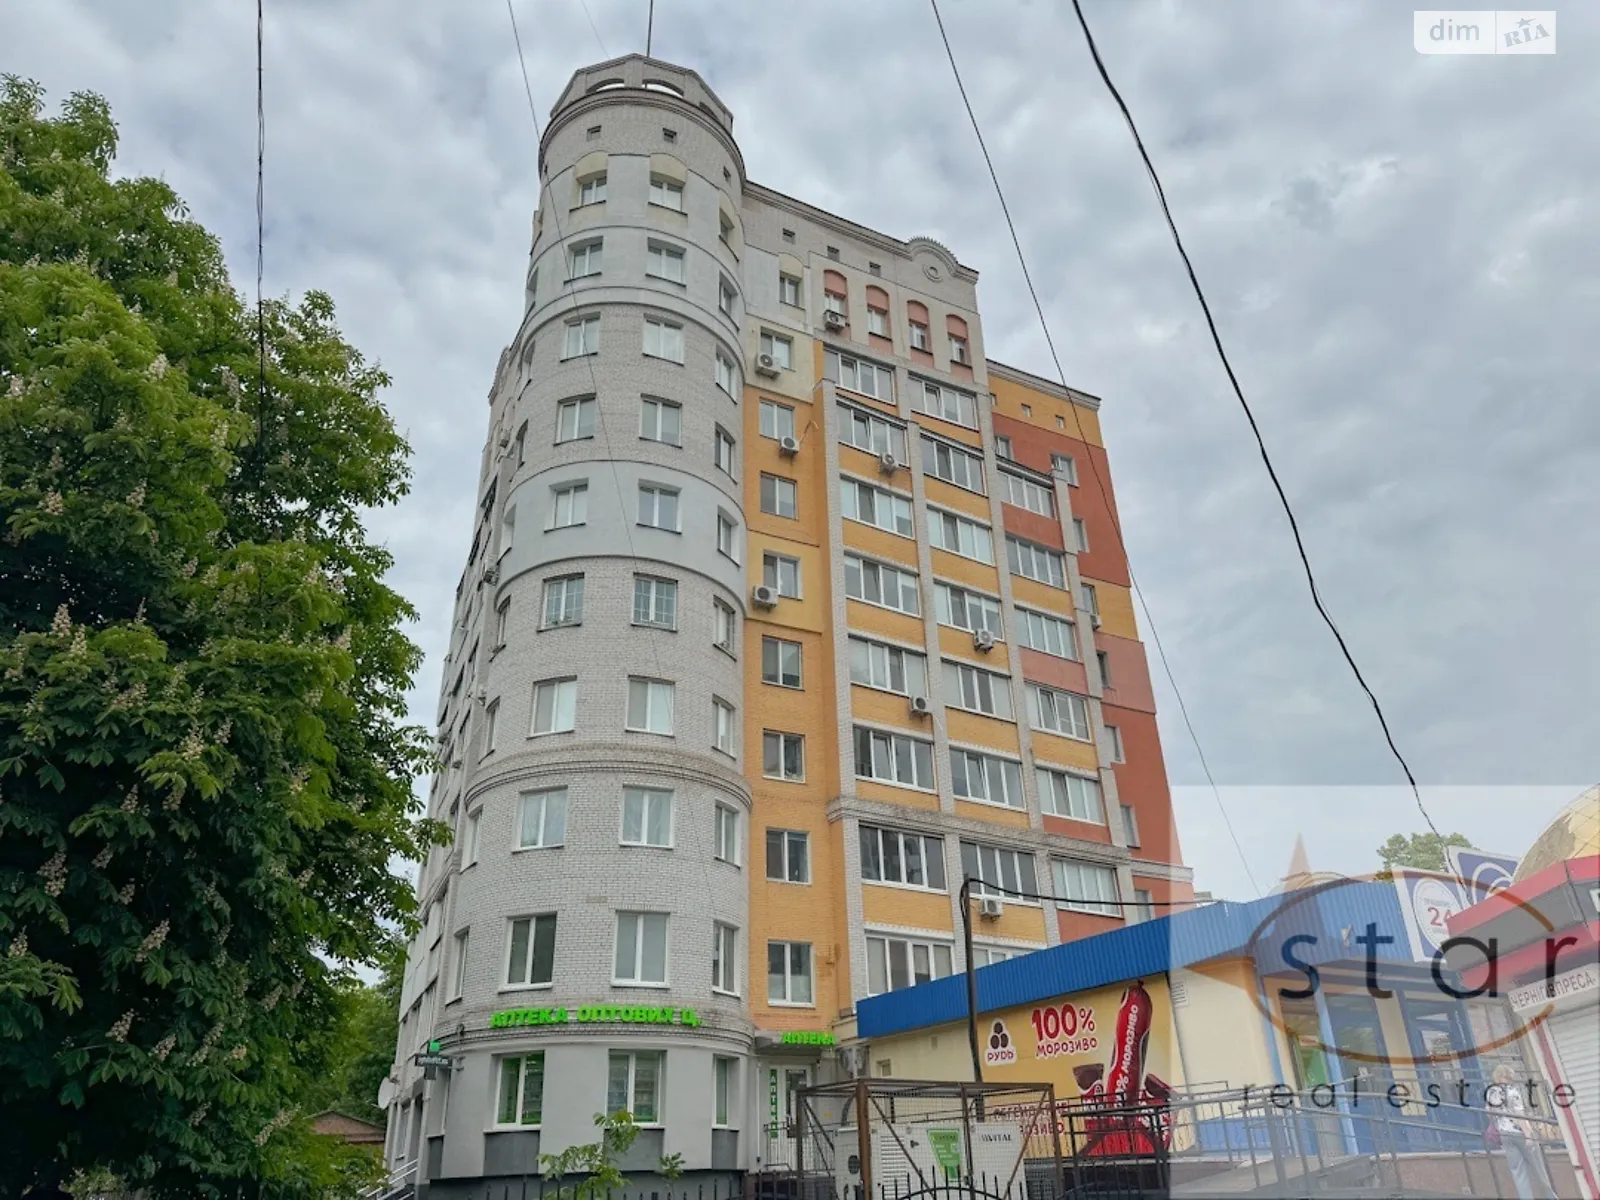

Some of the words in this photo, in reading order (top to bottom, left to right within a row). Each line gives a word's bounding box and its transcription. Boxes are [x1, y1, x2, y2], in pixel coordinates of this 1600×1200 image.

[489, 1007, 569, 1028] АПТЕКА
[576, 1006, 674, 1025] ОПТОВИХ
[1031, 1003, 1096, 1042] 100%
[782, 1031, 836, 1045] АПТЕКА
[1036, 1037, 1098, 1057] МОРОЗИВО
[1120, 1004, 1139, 1074] МОРОЗИВО
